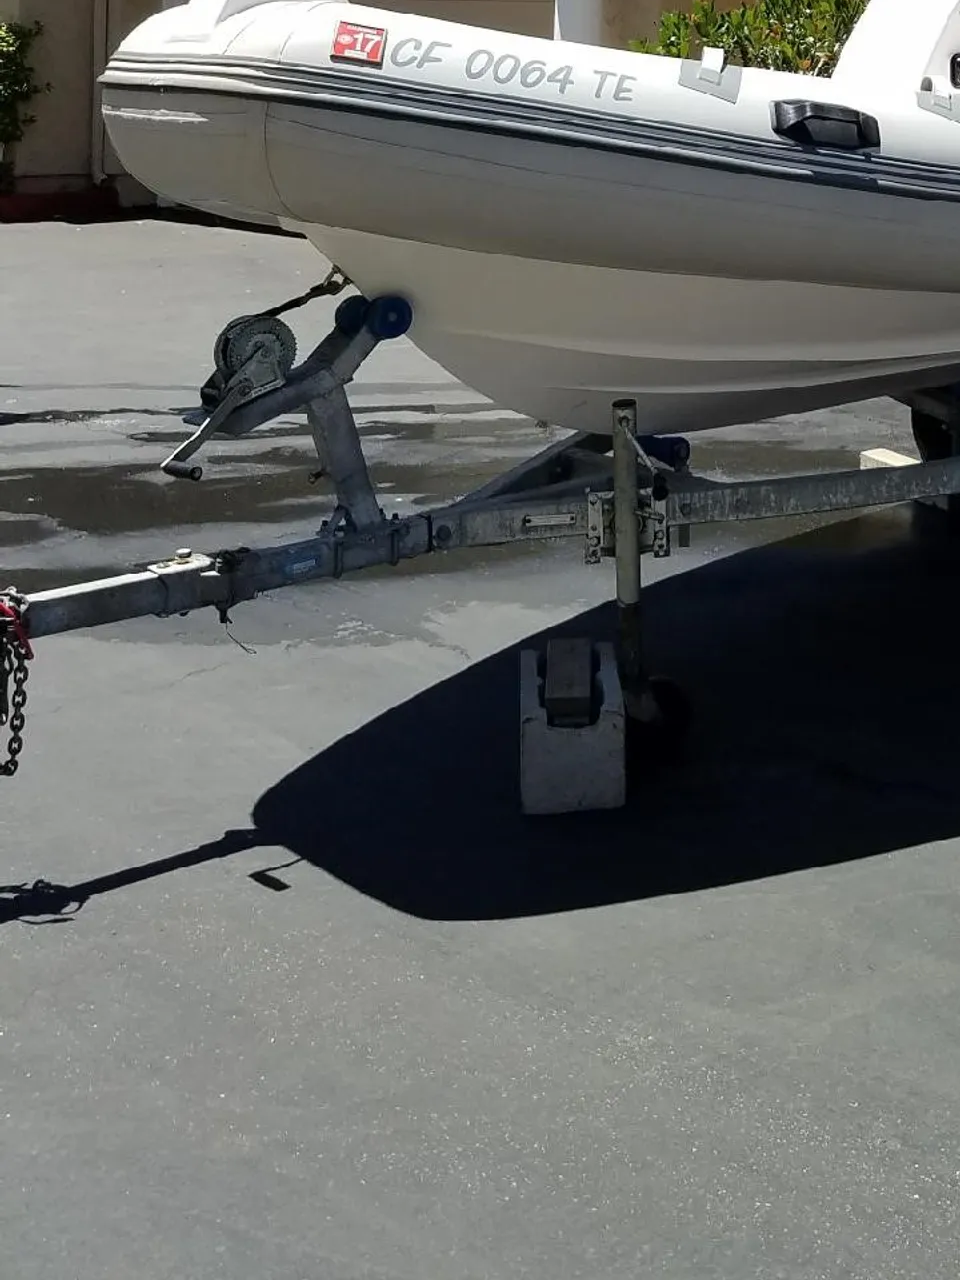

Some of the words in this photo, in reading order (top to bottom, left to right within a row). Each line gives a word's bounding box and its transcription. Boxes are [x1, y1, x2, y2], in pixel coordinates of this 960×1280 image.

[353, 32, 382, 53] 17
[390, 37, 452, 69] CF
[465, 49, 575, 94] 0064
[593, 69, 639, 102] TE
